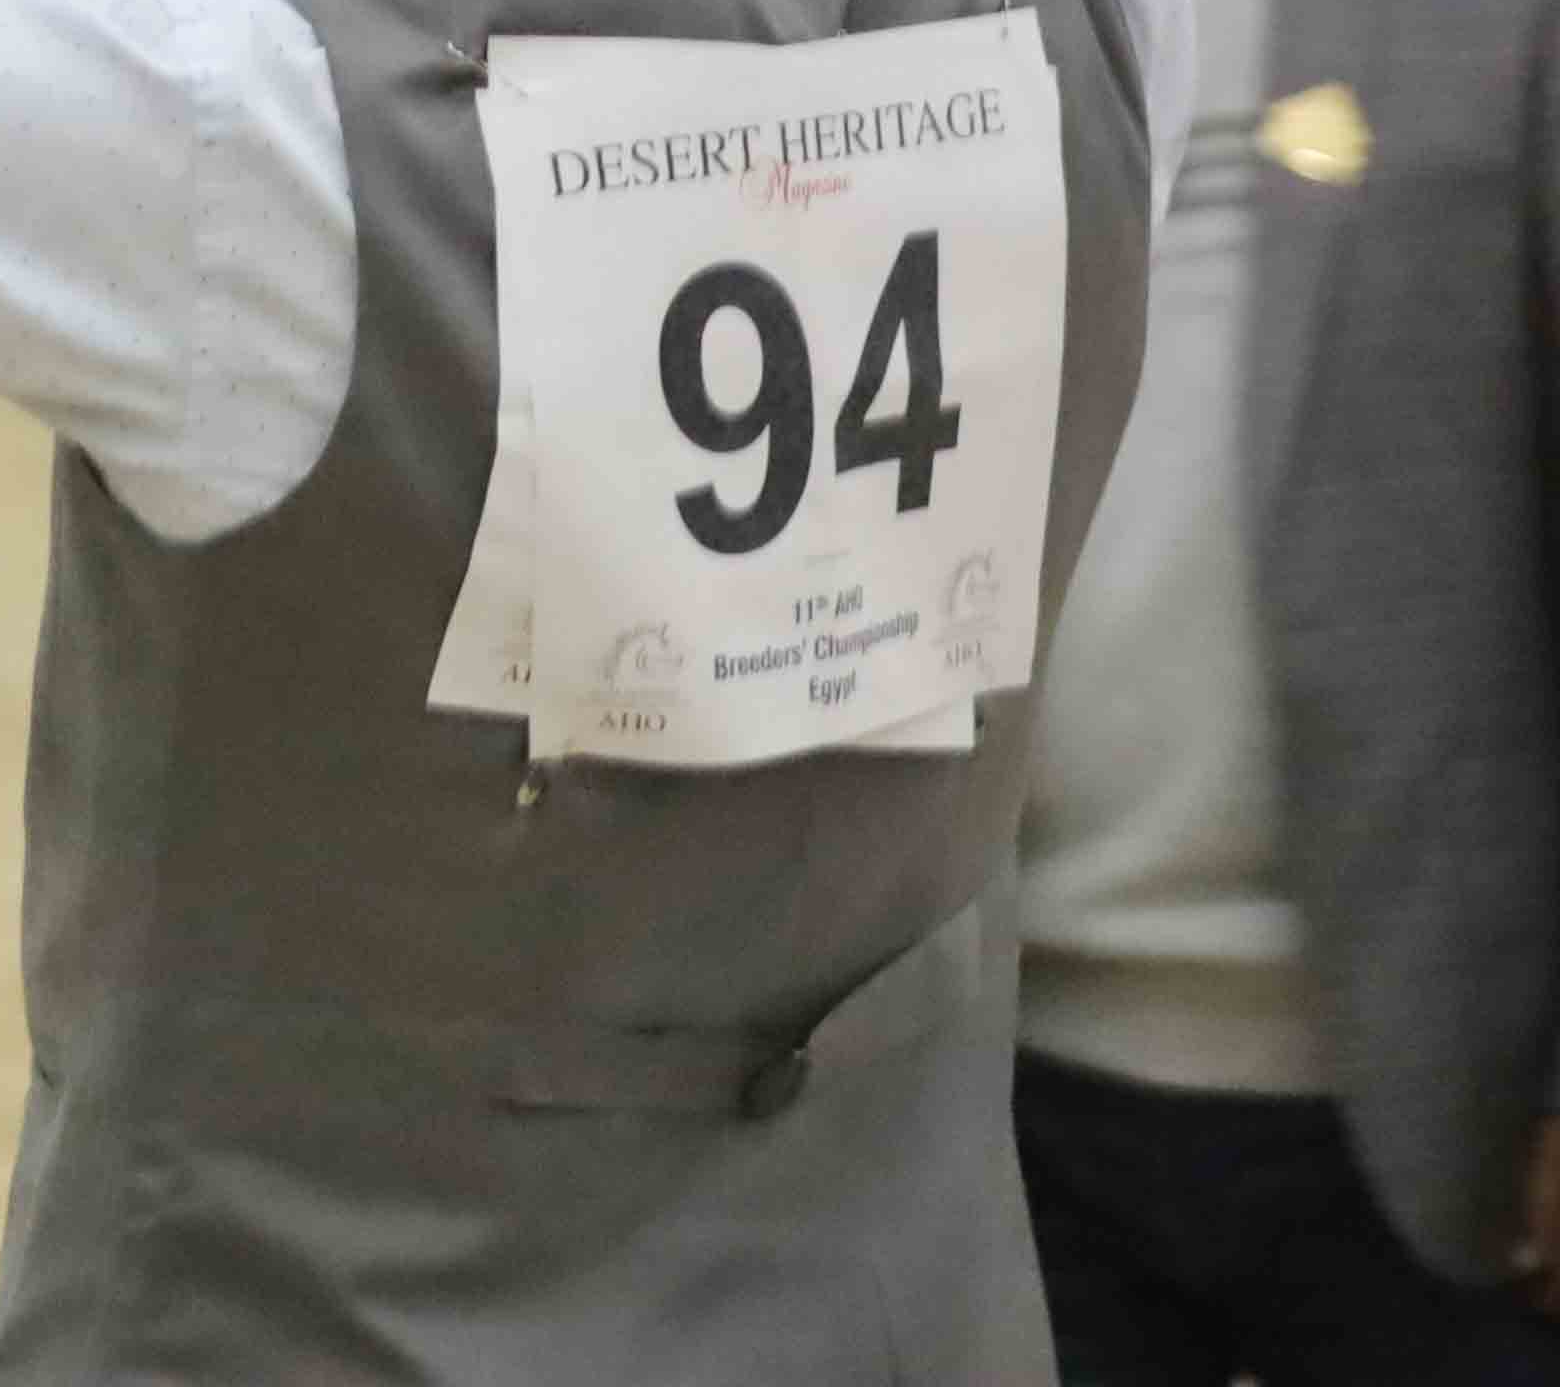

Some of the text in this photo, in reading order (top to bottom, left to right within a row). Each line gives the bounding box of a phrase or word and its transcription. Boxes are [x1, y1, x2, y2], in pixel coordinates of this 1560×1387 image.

[549, 88, 1006, 197] DESERT HERITAGE
[658, 228, 962, 555] 94
[712, 638, 807, 681] Breeders'
[808, 667, 857, 706] Egypt
